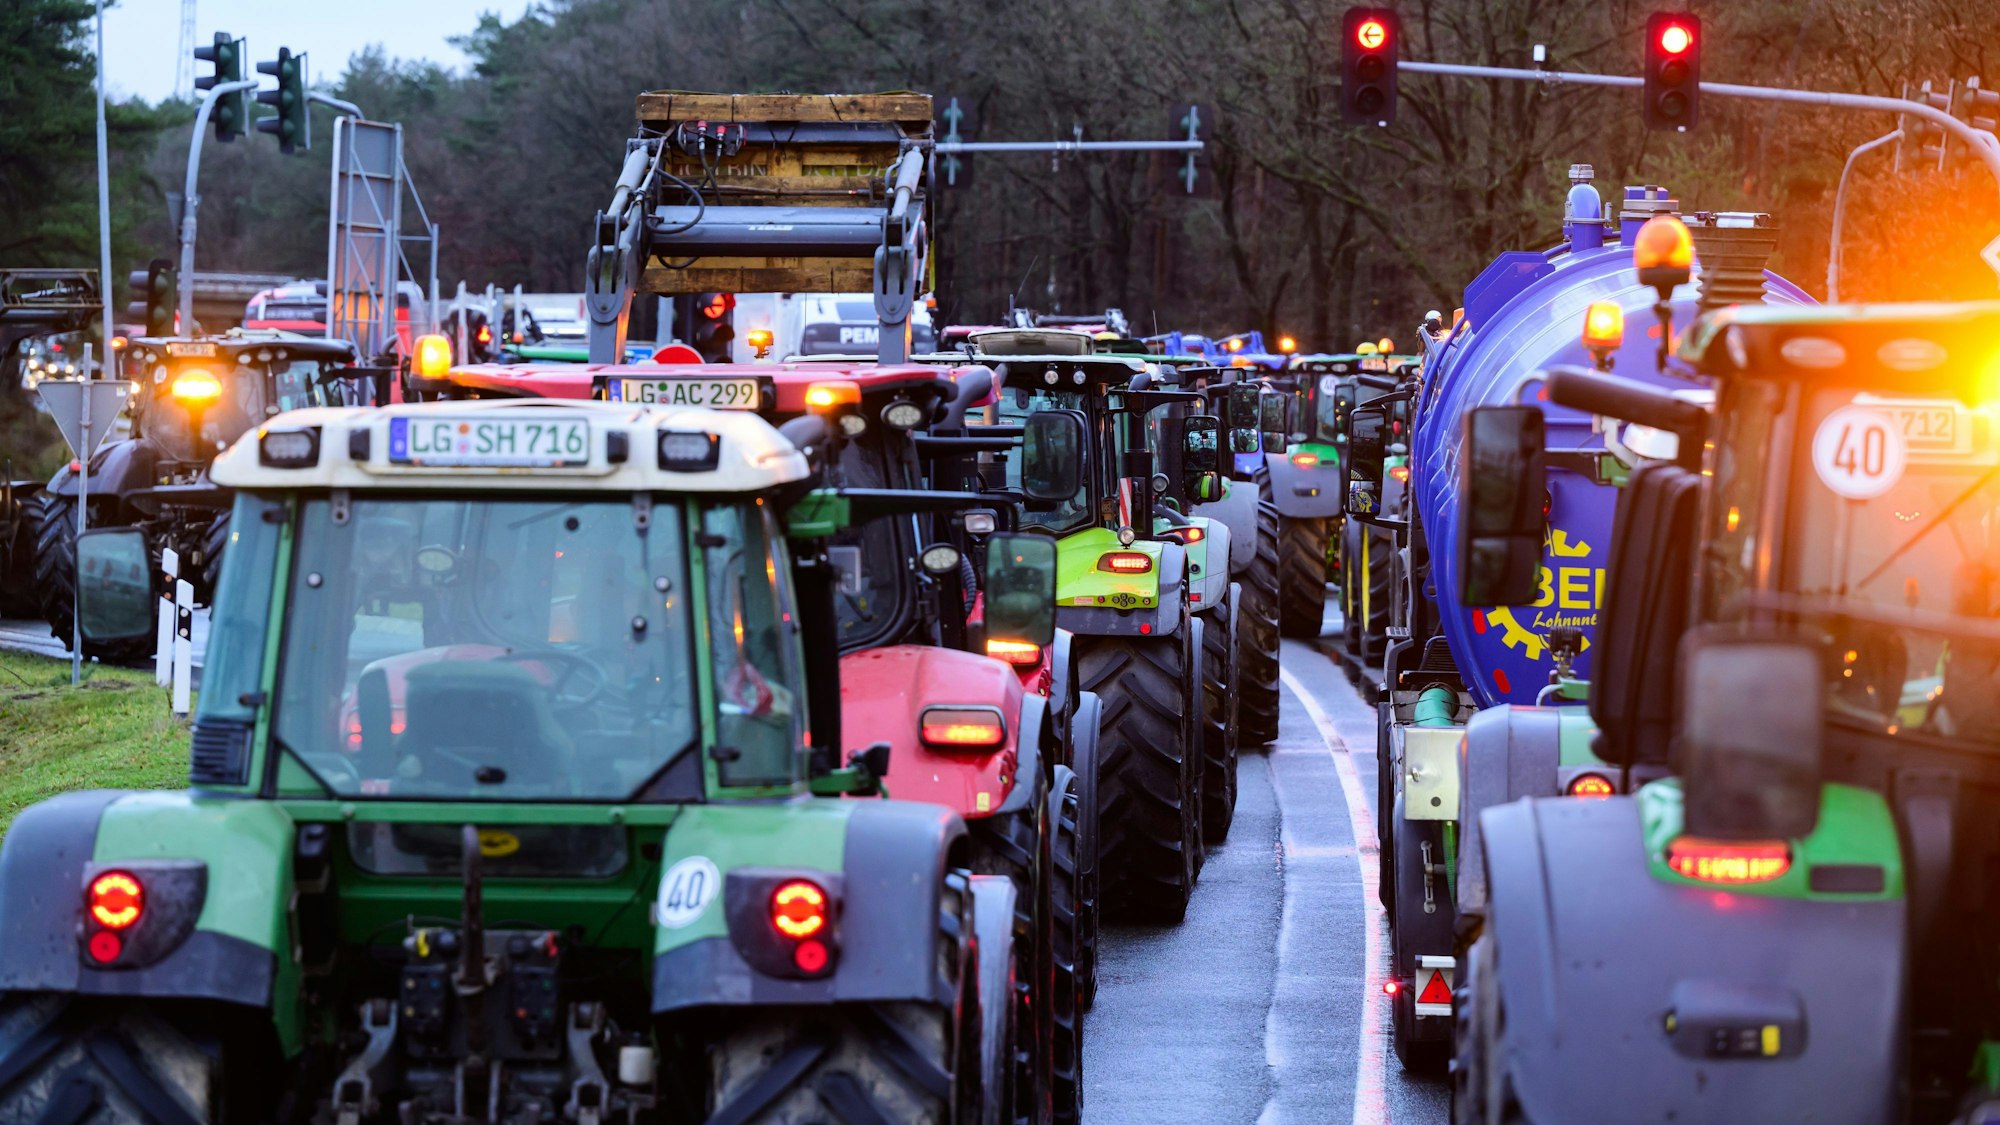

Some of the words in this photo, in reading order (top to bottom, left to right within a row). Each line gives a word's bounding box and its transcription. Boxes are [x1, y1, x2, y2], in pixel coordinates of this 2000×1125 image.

[840, 327, 879, 344] PEM
[625, 382, 655, 404] LG
[673, 382, 703, 405] AC
[710, 382, 753, 405] 299
[1901, 411, 1949, 437] 712
[412, 424, 451, 452] LG
[475, 424, 515, 453] SH
[526, 424, 582, 453] 716
[1833, 423, 1886, 477] 40
[1532, 611, 1597, 628] Lohnunt
[667, 870, 704, 911] 40
